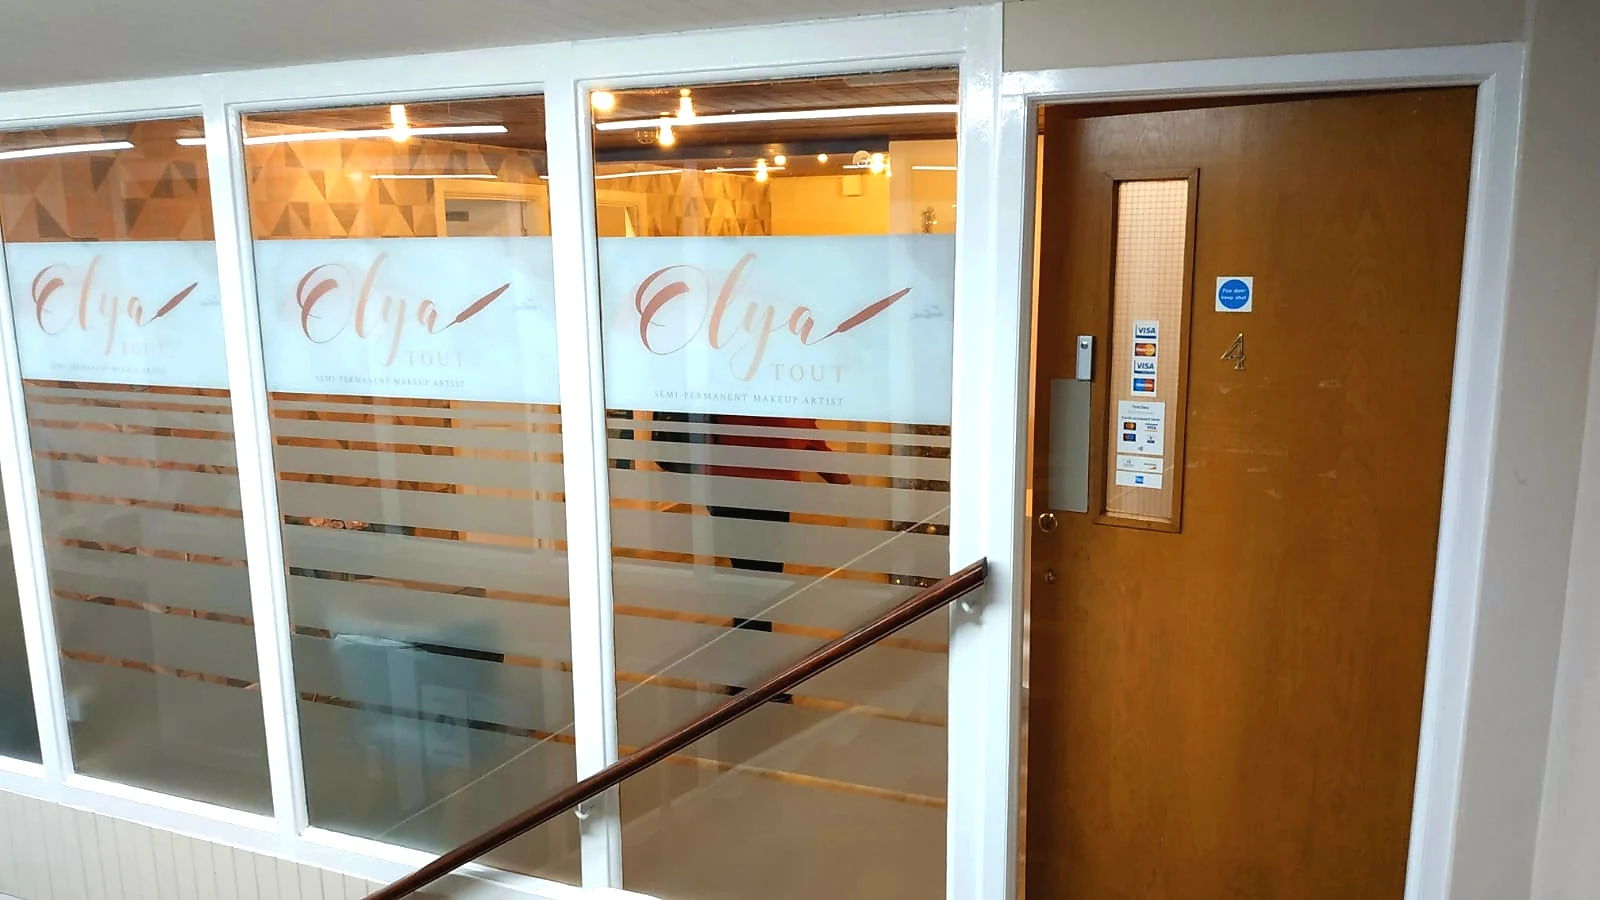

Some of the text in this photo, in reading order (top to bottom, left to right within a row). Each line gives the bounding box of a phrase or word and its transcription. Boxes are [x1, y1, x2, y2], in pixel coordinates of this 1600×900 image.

[32, 254, 146, 356] Olya
[297, 252, 441, 367] Olya
[635, 252, 820, 382] Olya
[407, 349, 463, 368] TOUT
[1137, 362, 1155, 370] VISA
[1220, 333, 1245, 370] 4
[769, 363, 846, 384] TOUT
[653, 389, 845, 407] SEMI-PERMANENT MAKEUP ARTIST
